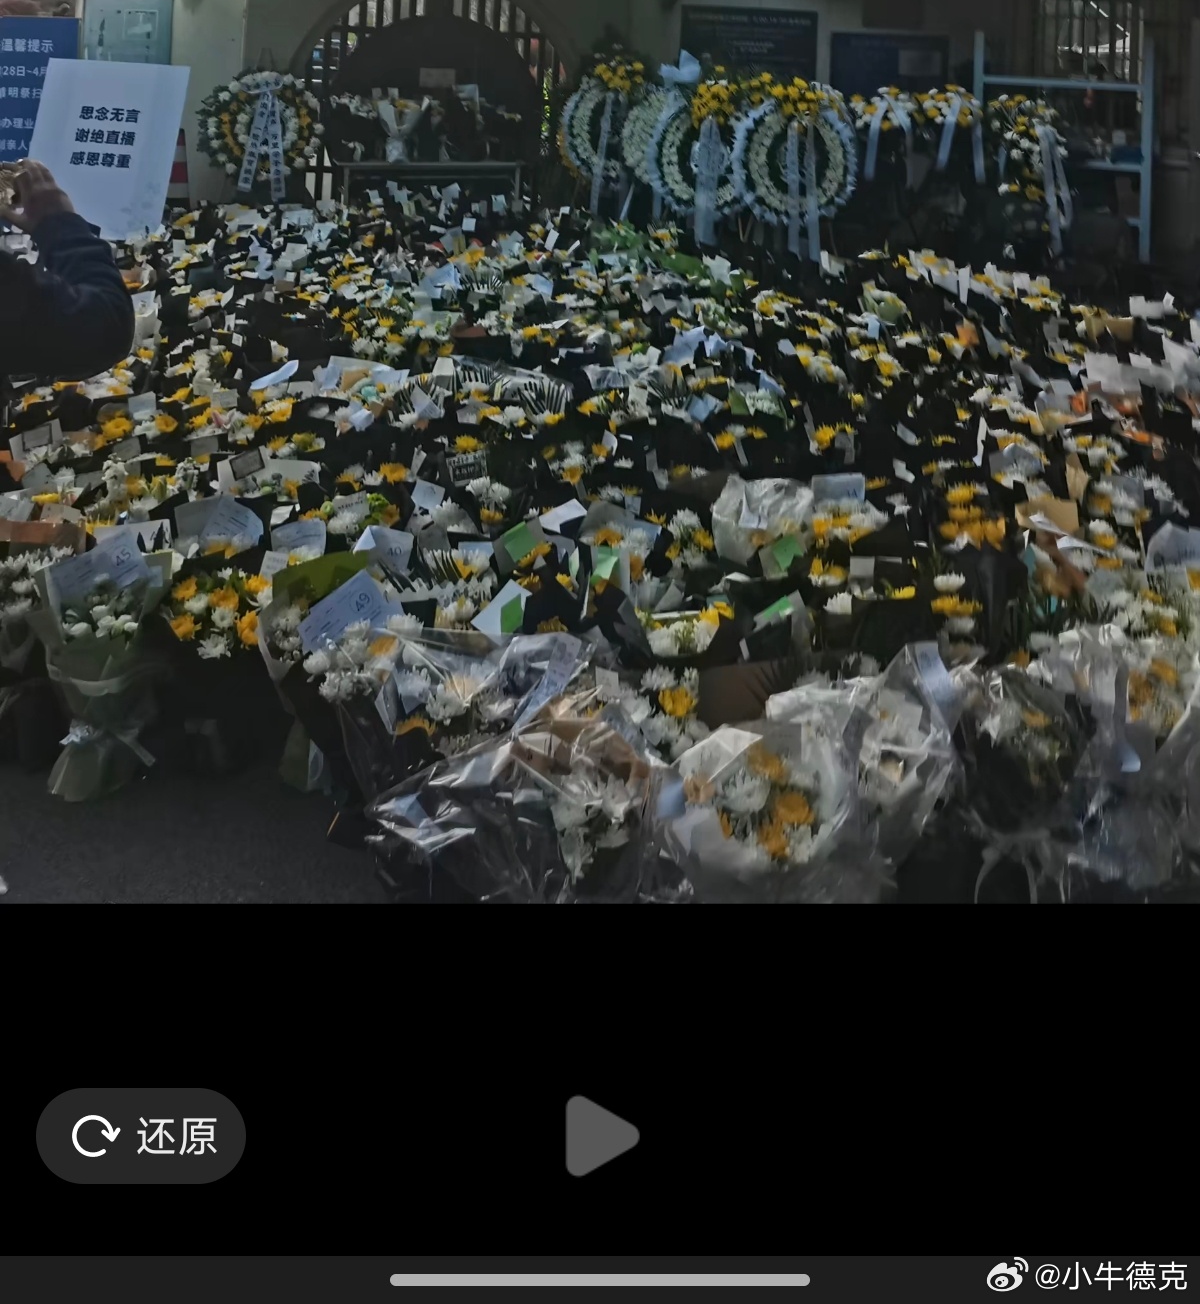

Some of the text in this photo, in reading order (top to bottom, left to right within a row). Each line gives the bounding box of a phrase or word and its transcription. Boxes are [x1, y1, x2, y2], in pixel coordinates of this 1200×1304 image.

[0, 65, 47, 77] 28日~4月
[79, 105, 141, 123] 思念无言
[75, 128, 136, 146] 谢绝直播
[70, 151, 131, 169] 感恩尊重
[115, 548, 132, 566] 45
[354, 592, 371, 612] 49
